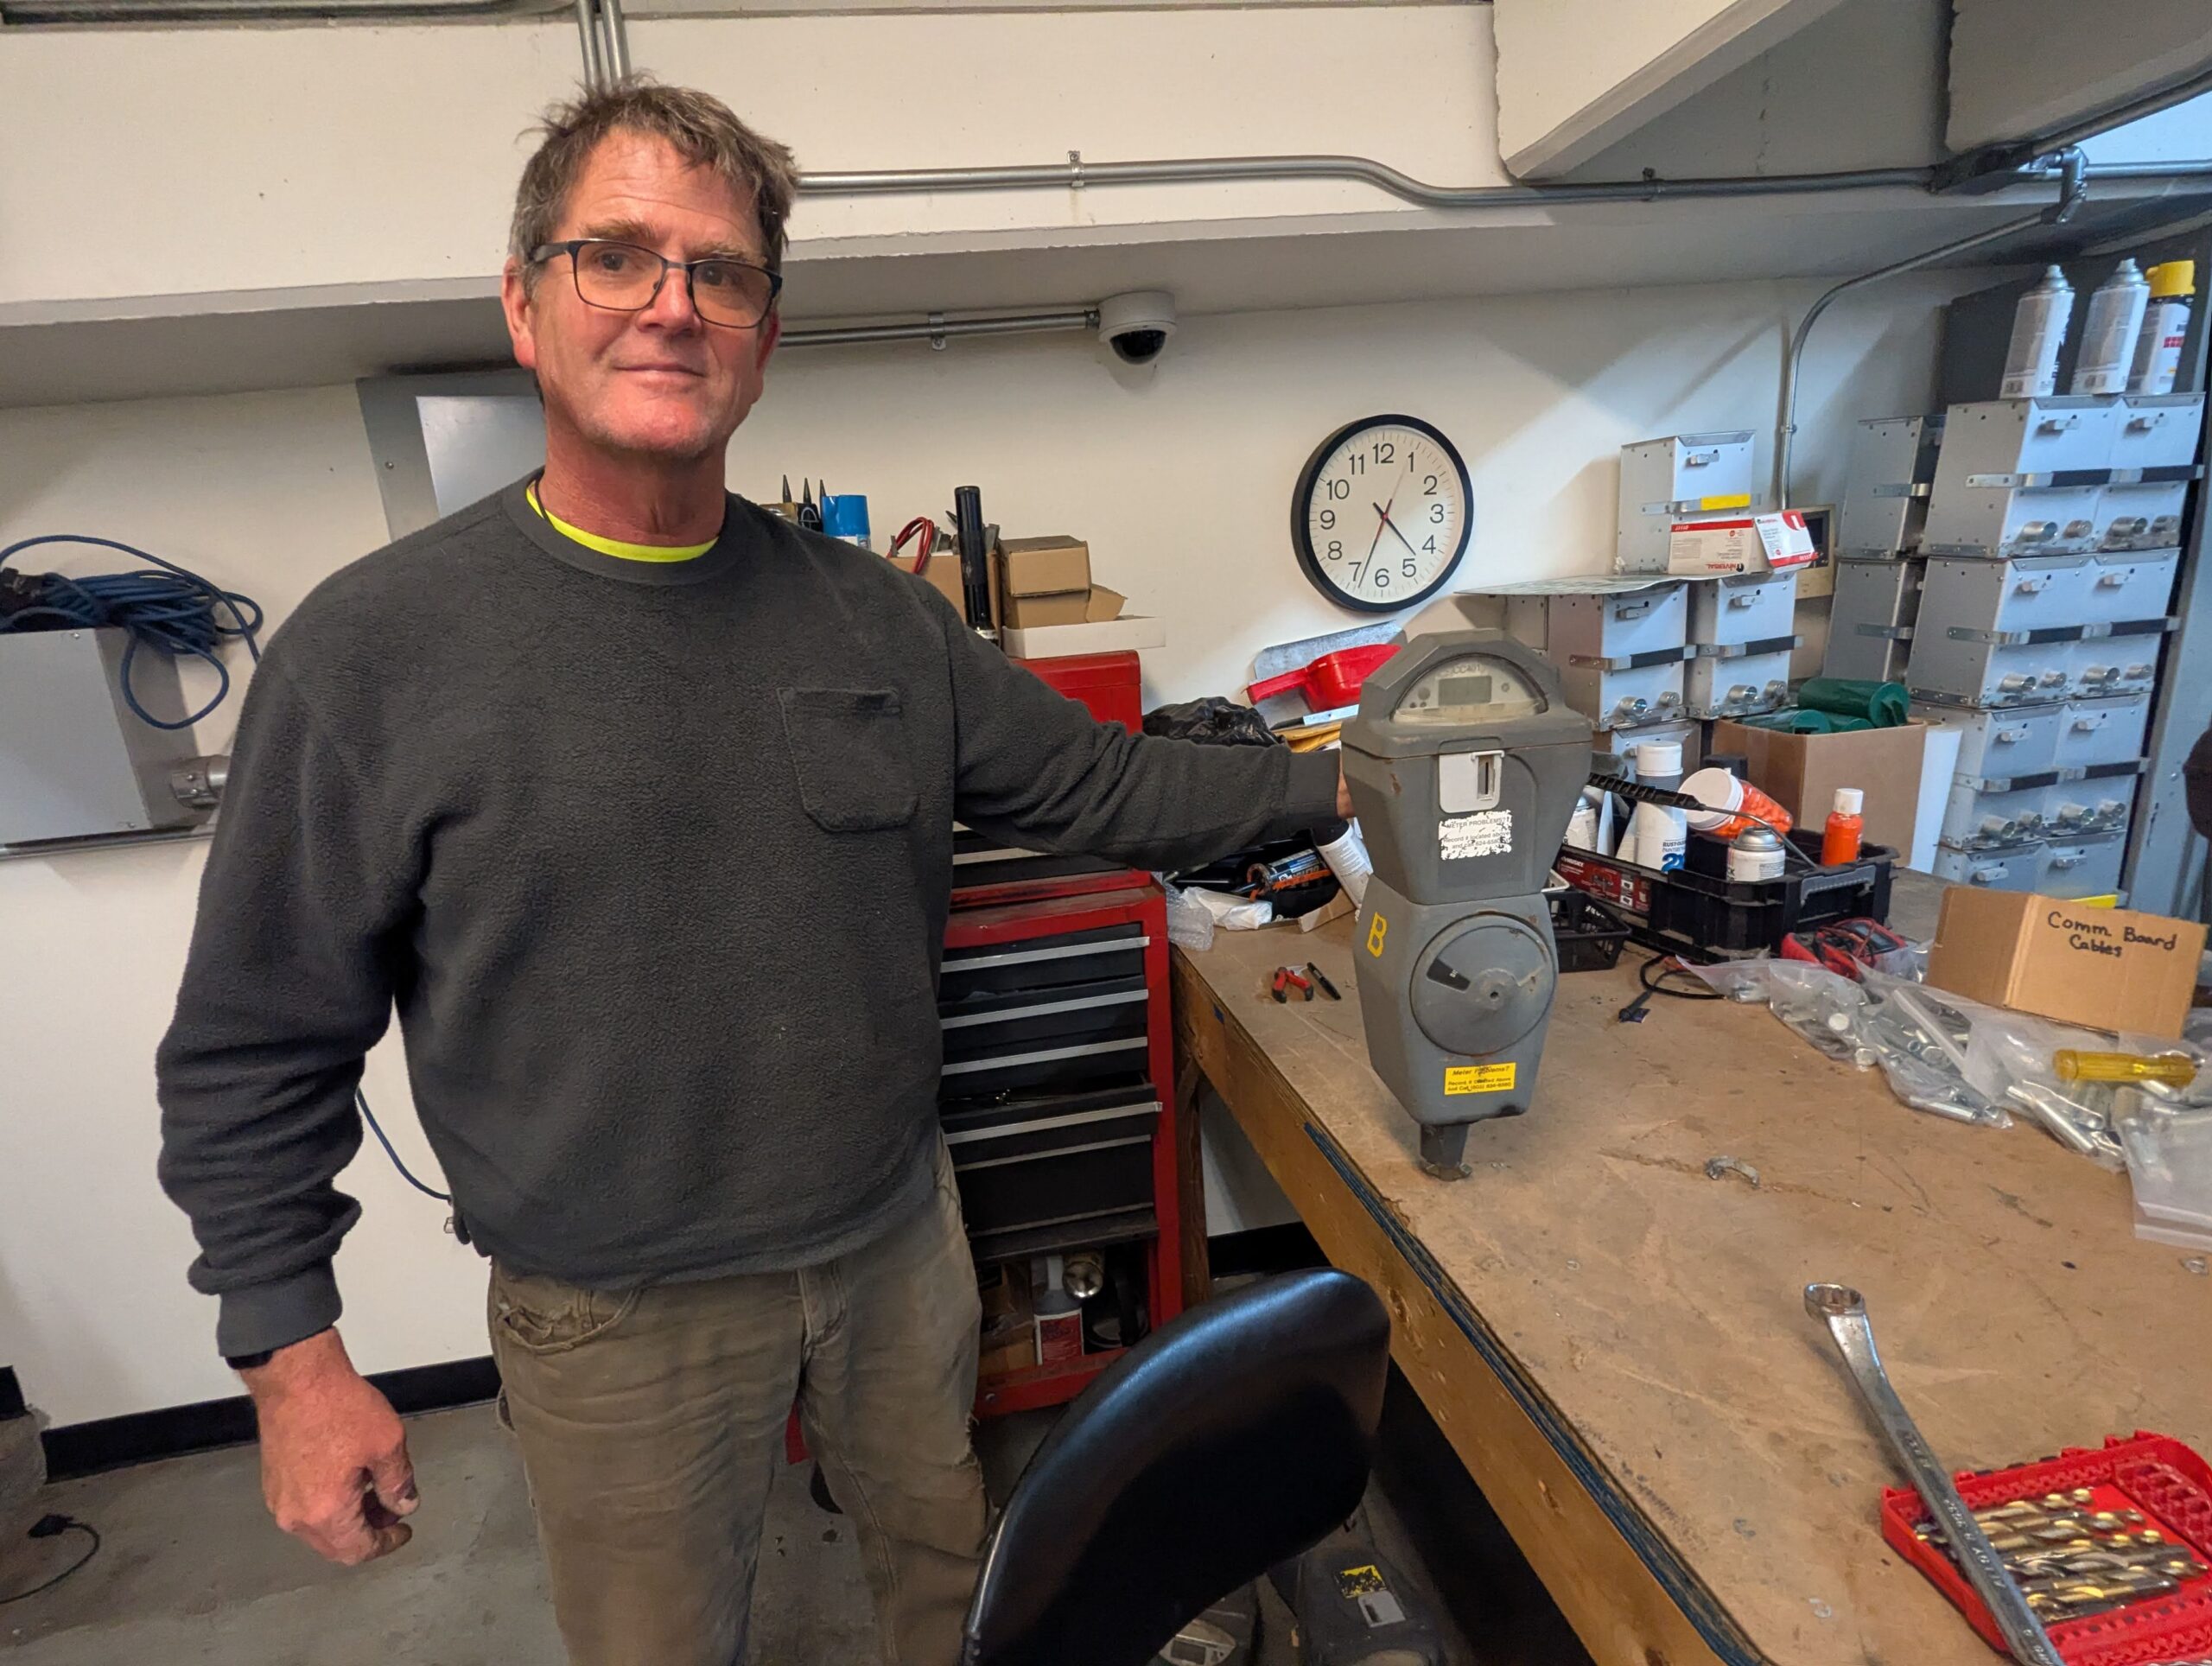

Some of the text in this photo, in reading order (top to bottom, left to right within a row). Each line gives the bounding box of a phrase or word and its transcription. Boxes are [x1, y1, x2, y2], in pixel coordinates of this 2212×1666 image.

[1348, 453, 1365, 475] 11
[1372, 442, 1395, 465] 12
[1408, 451, 1414, 473] 1
[1325, 478, 1351, 501] 10
[1423, 474, 1438, 496] 2
[1319, 509, 1336, 531] 9
[1429, 503, 1445, 525] 3
[1327, 539, 1343, 561] 8
[1421, 534, 1437, 555] 4
[1347, 561, 1363, 582] 7
[1374, 568, 1390, 588] 6
[1402, 557, 1417, 578] 5
[1367, 912, 1387, 958] B
[2069, 934, 2122, 957] Cables
[2123, 926, 2177, 951] Board
